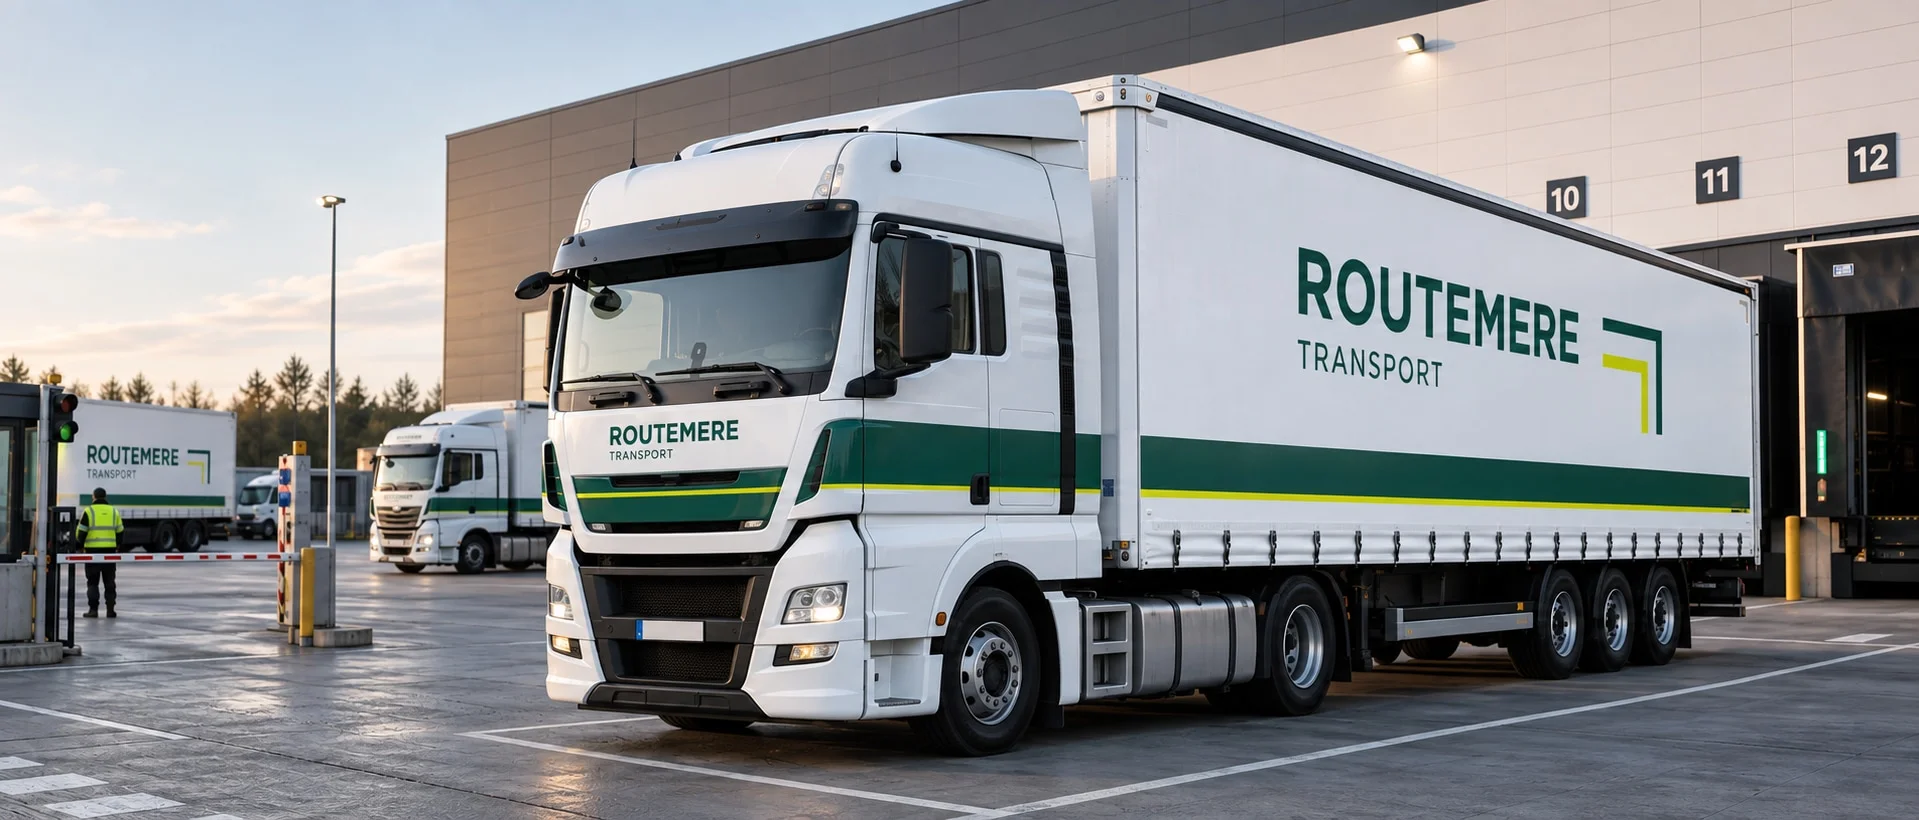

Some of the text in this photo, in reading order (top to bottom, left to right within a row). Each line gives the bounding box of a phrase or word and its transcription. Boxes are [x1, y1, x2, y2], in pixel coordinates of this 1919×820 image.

[1853, 144, 1889, 173] 12
[1701, 166, 1729, 195] 11
[1551, 185, 1580, 213] 10
[1297, 246, 1580, 365] ROUTEMERE
[1297, 339, 1443, 388] TRANSPORT
[609, 419, 739, 446] ROUTEMERE
[87, 444, 179, 466] ROUTEMERE
[609, 448, 673, 461] TRANSPORT
[87, 468, 137, 479] TRANSPORT
